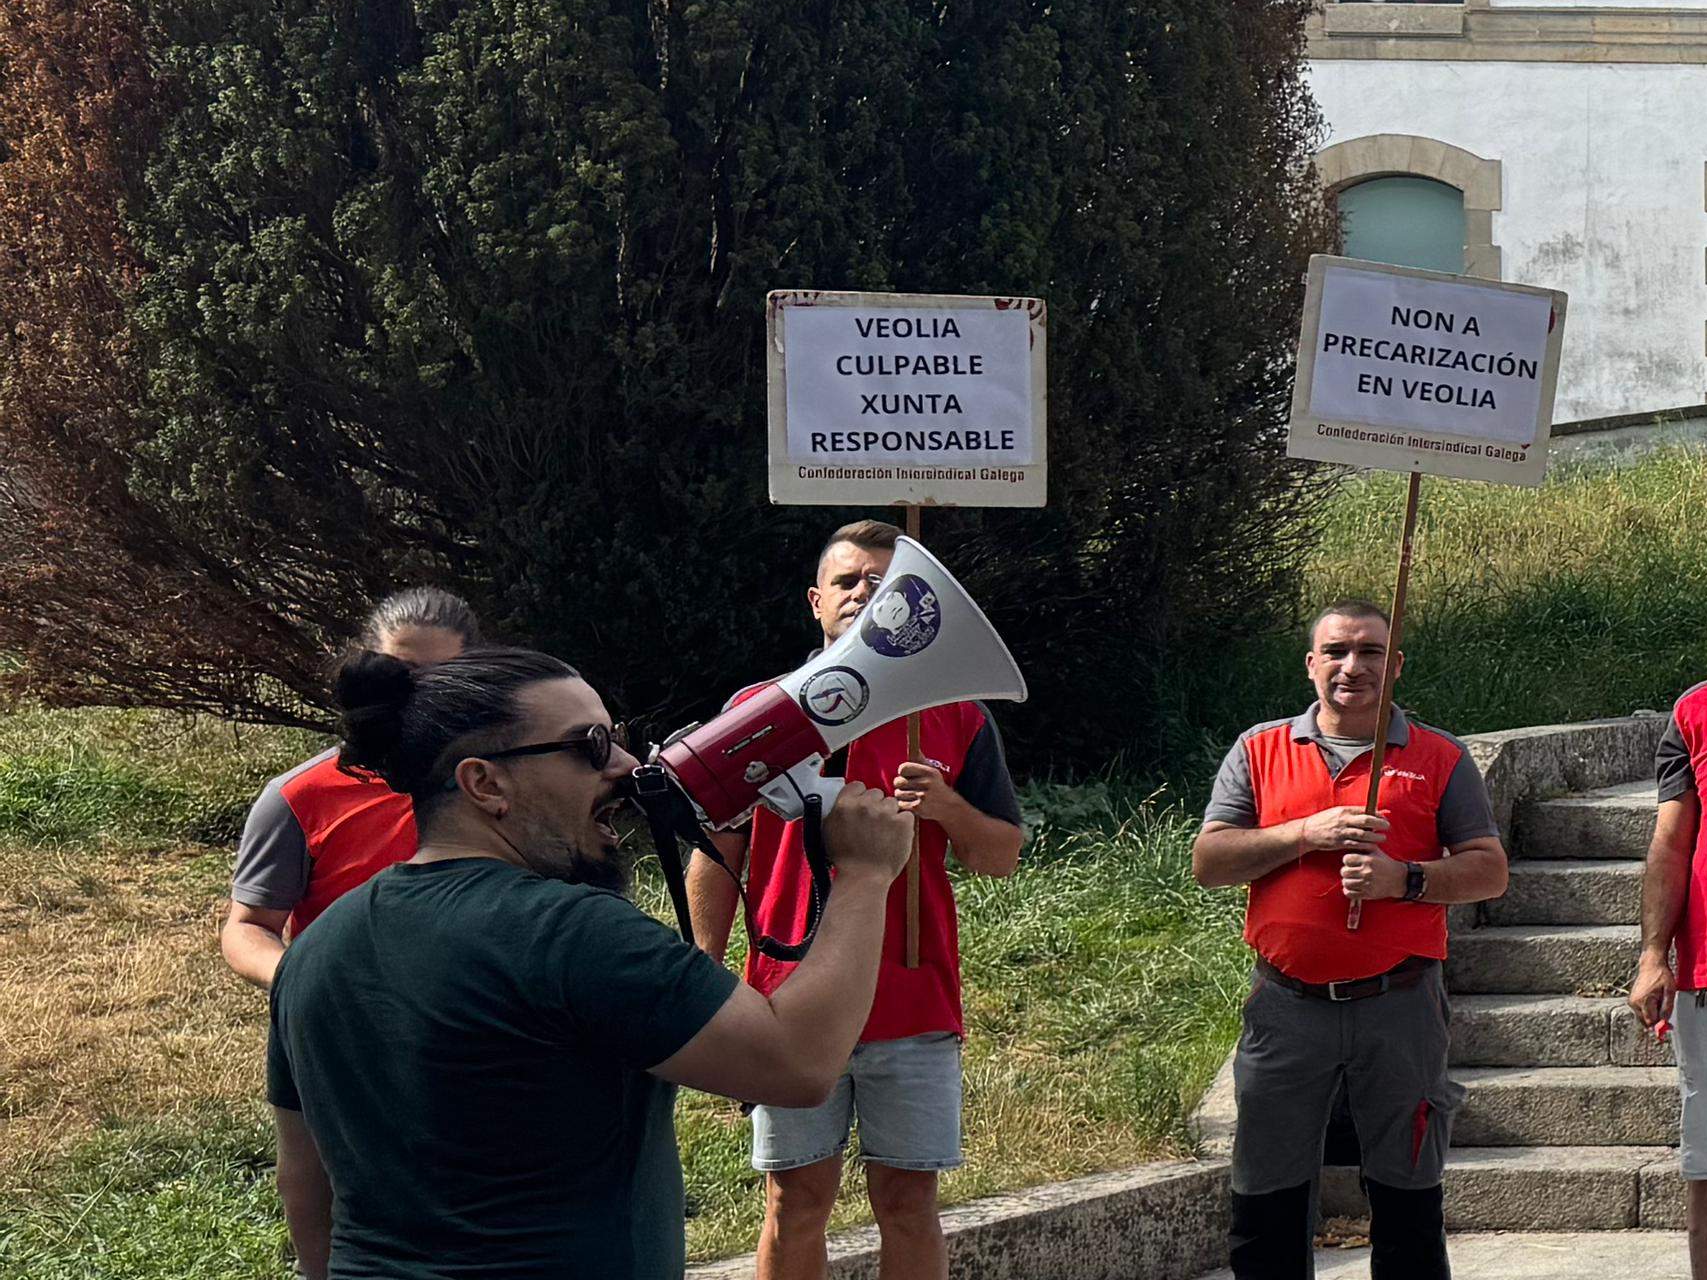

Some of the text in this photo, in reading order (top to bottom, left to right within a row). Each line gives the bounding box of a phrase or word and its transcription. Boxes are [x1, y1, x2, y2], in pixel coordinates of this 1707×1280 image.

[855, 318, 961, 338] VEOLIA
[1391, 306, 1480, 337] NON A
[836, 355, 983, 376] CULPABLE
[1323, 333, 1538, 380] PRECARIZACIÓN
[1357, 373, 1497, 409] EN VEOLIA
[860, 393, 963, 414] XUNTA
[811, 430, 1015, 453] RESPONSABLE
[1317, 423, 1527, 463] Confederación Intersindical Galega
[798, 465, 893, 481] Confederación
[980, 468, 1025, 483] Galega
